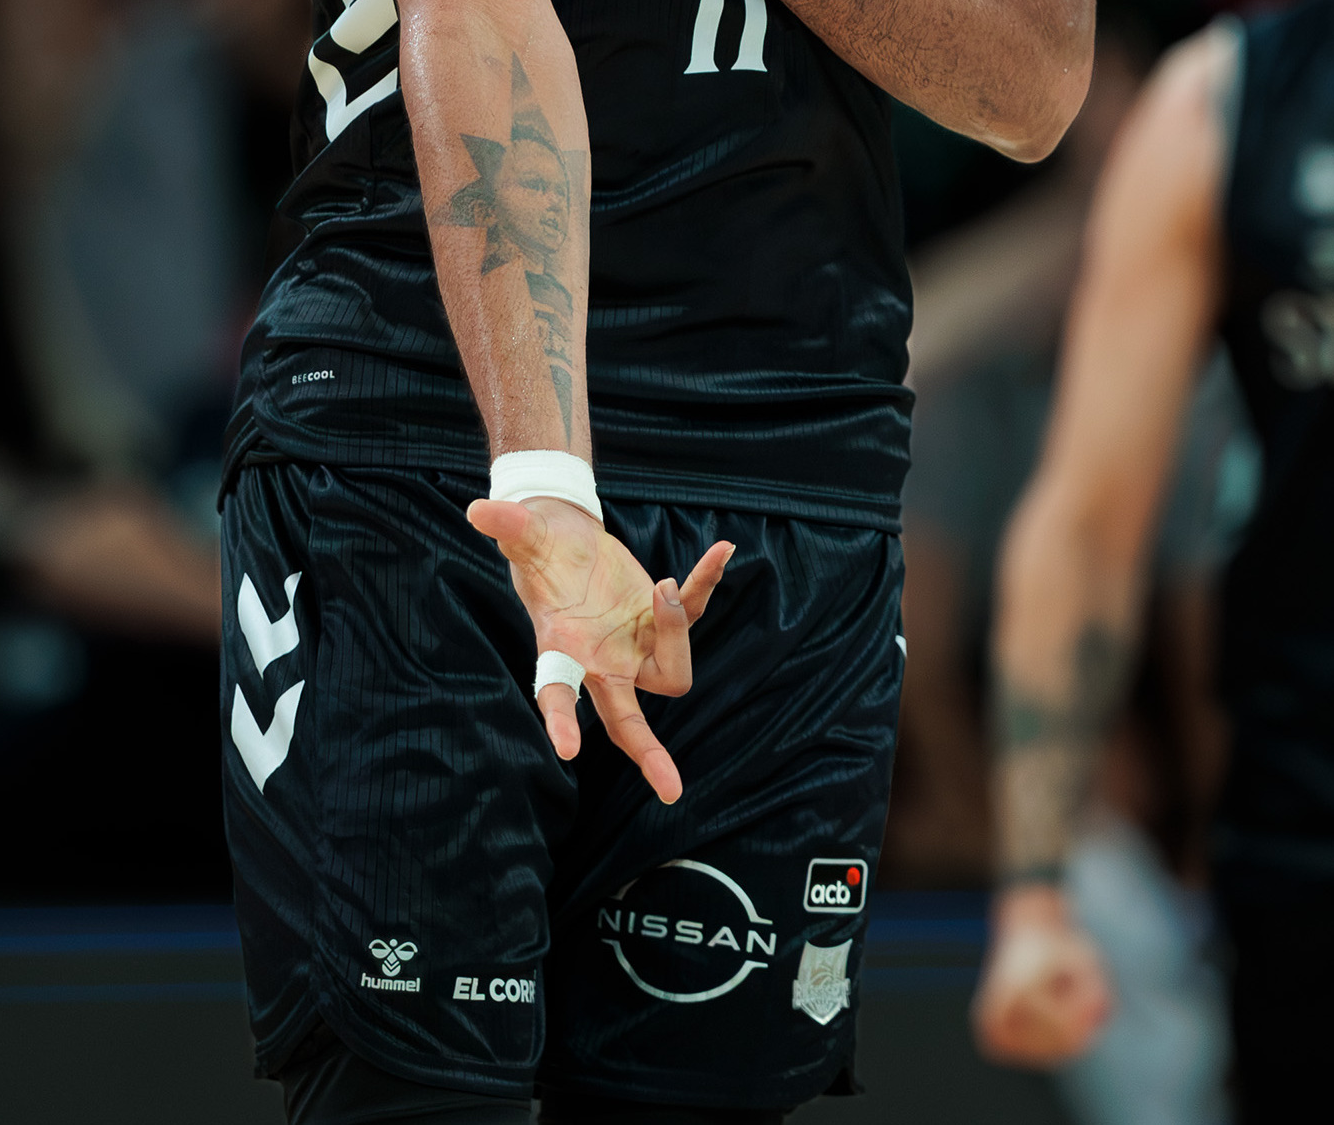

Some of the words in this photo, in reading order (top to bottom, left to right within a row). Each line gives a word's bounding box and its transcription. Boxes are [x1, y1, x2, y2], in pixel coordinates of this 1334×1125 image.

[292, 370, 335, 385] BEECOOL
[810, 880, 851, 905] acb
[598, 908, 777, 956] NISSAN
[361, 972, 421, 993] hummel
[453, 976, 486, 1001] EL
[489, 978, 536, 1004] CORR
